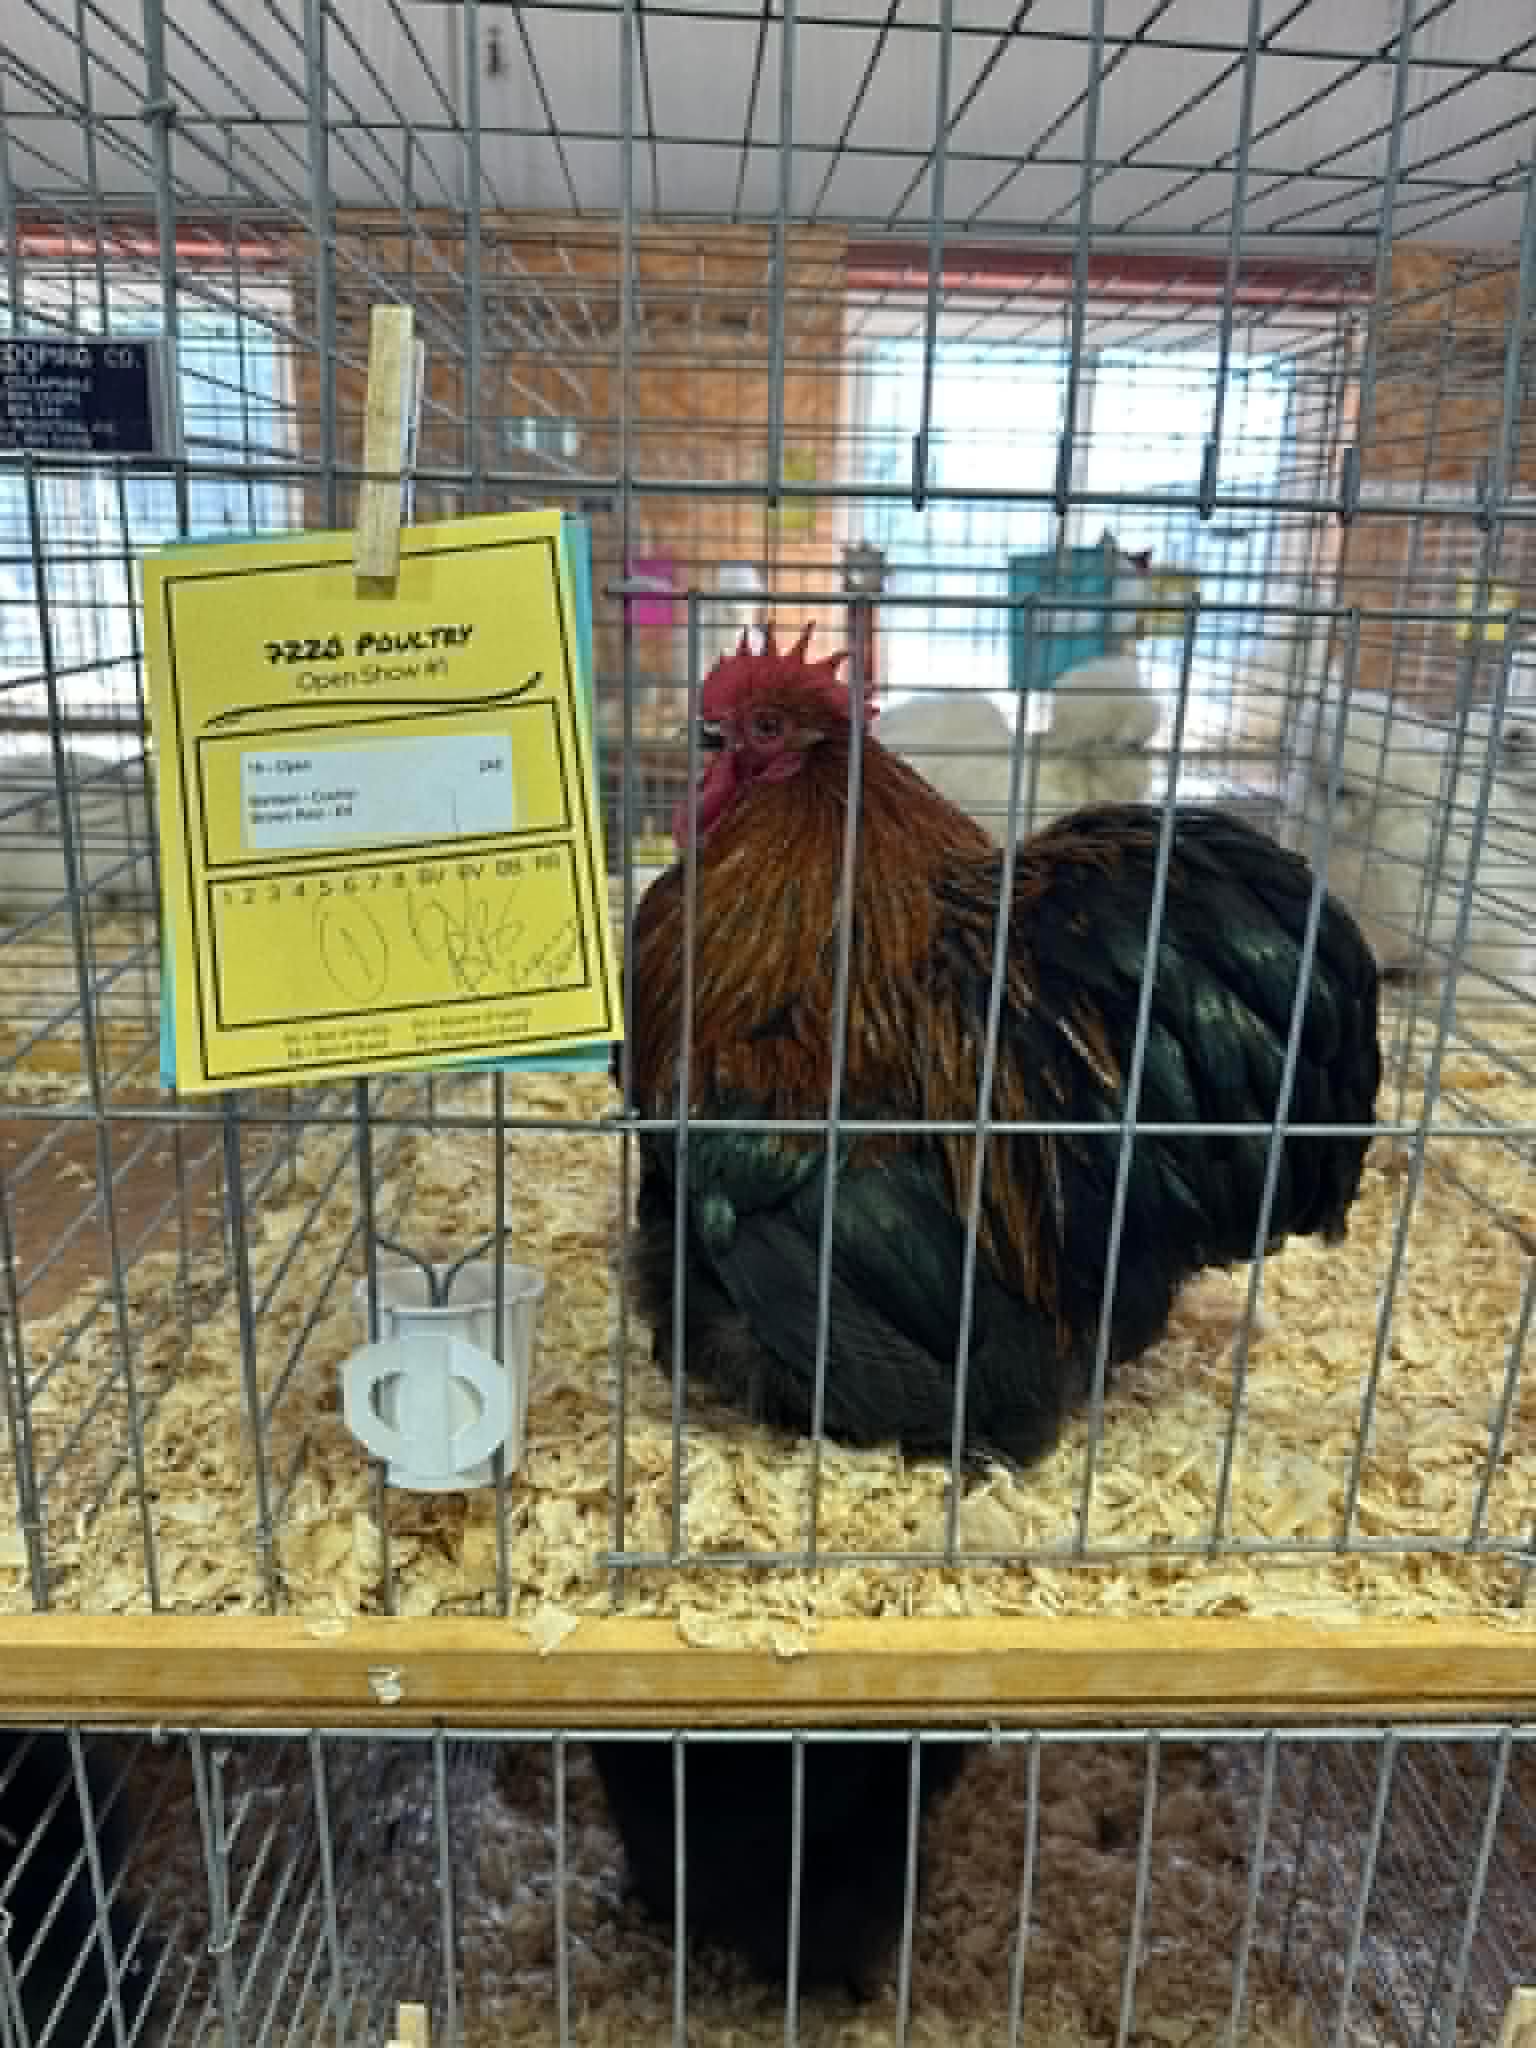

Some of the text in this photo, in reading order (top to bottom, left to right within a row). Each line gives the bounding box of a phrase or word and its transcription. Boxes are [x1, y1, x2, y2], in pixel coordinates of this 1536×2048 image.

[354, 624, 473, 657] POULTRY
[296, 669, 357, 694] Open
[361, 663, 420, 685] Show
